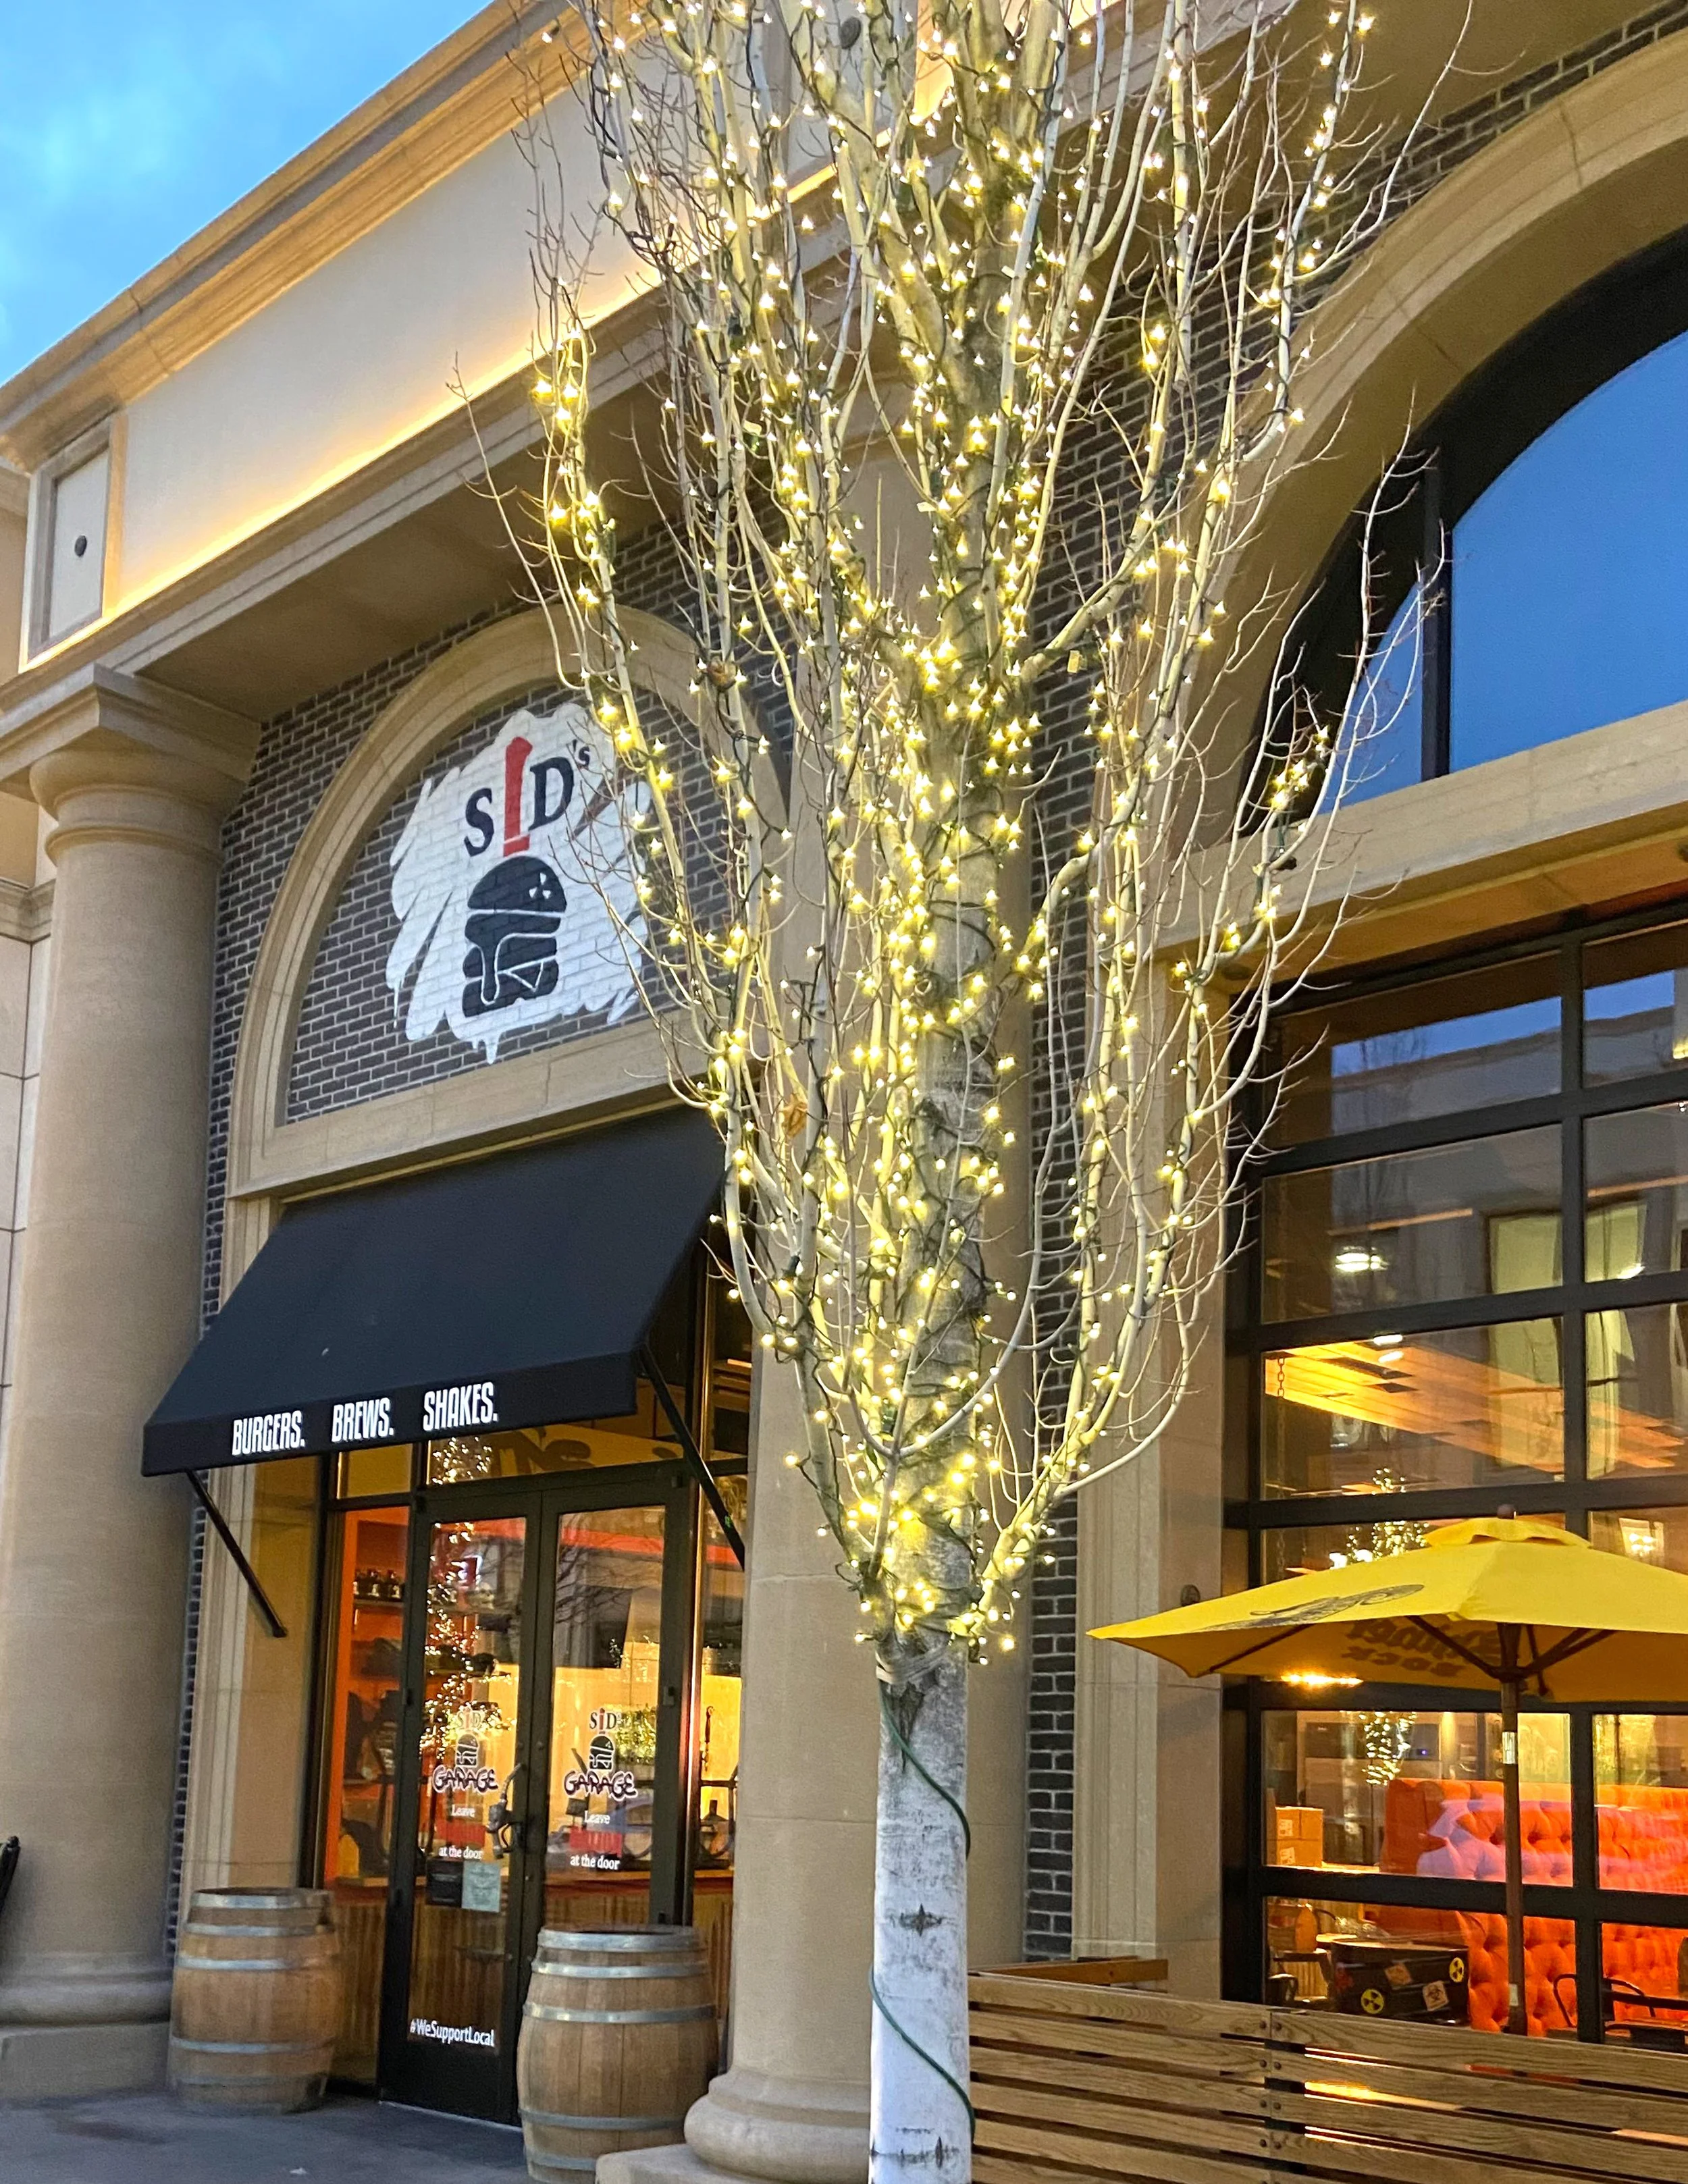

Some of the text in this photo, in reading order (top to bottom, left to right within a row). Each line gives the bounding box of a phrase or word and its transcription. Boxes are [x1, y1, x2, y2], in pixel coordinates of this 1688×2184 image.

[232, 1381, 498, 1456] BURGERS. BREWS. SHAKES.
[433, 1765, 498, 1793] GARAGE
[564, 1771, 637, 1799] GARAGE
[451, 1804, 476, 1818] Leave
[584, 1810, 610, 1825] Leave
[438, 1844, 483, 1860] at the door
[570, 1853, 621, 1870] at the door
[410, 2019, 494, 2047] #WeSupportLocal
